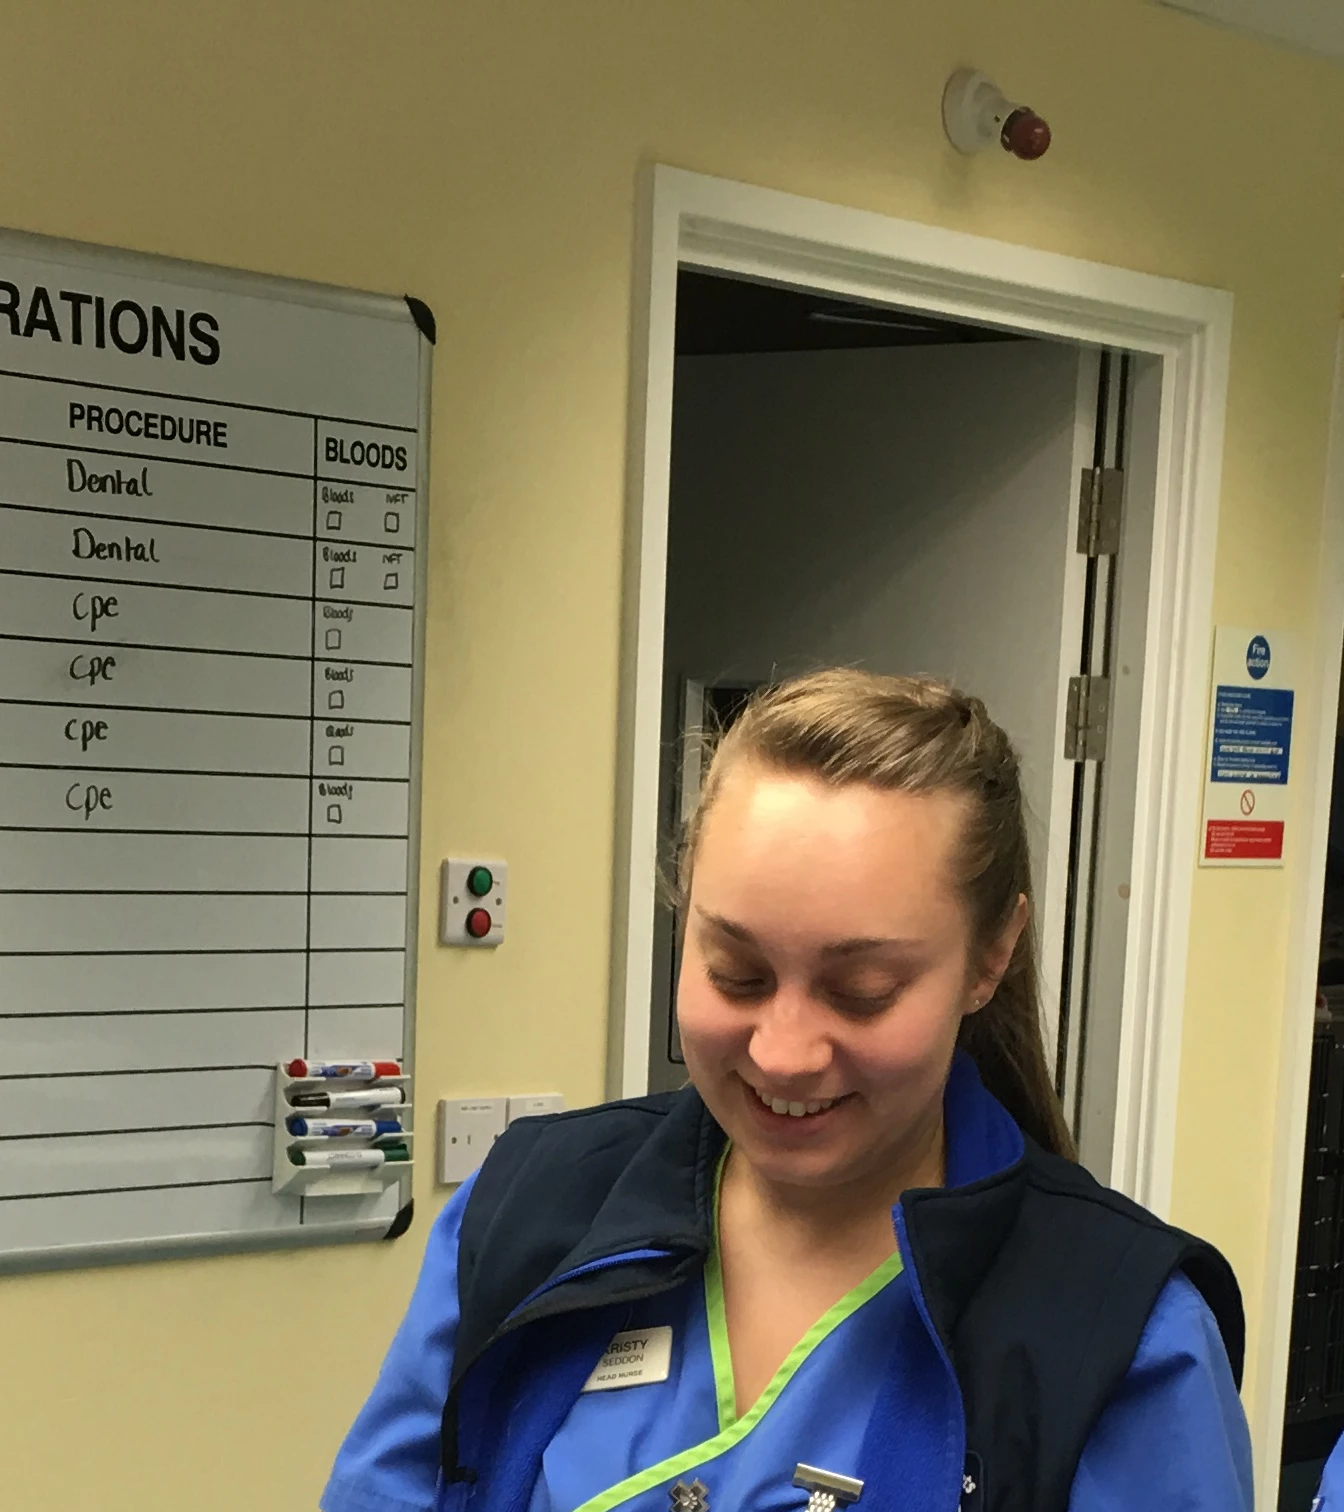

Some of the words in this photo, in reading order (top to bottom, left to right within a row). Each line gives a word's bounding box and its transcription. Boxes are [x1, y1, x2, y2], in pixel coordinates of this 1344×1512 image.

[69, 402, 228, 448] PROCEDURE
[325, 437, 407, 471] BLOODS
[66, 458, 154, 497] Dental
[72, 527, 160, 563] Dental
[597, 1373, 617, 1382] HEAD
[602, 1354, 644, 1368] SEDDON
